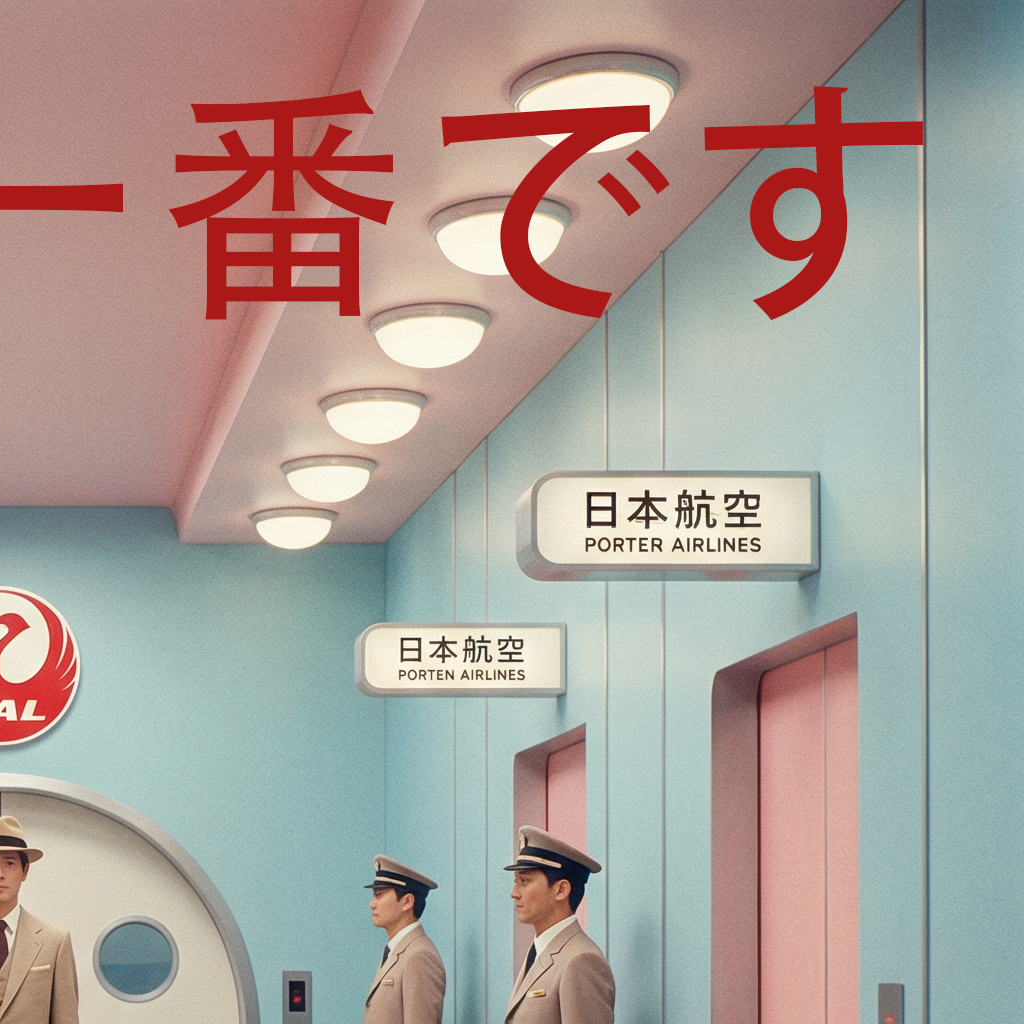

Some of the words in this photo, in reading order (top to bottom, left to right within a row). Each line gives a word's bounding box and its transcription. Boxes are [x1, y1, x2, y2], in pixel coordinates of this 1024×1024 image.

[586, 489, 762, 531] 日本航空
[585, 537, 663, 553] PORTER
[671, 537, 762, 553] AIRLINES
[399, 635, 525, 664] 日本航空
[398, 669, 455, 681] PORTEN
[460, 669, 526, 681] AIRLINES
